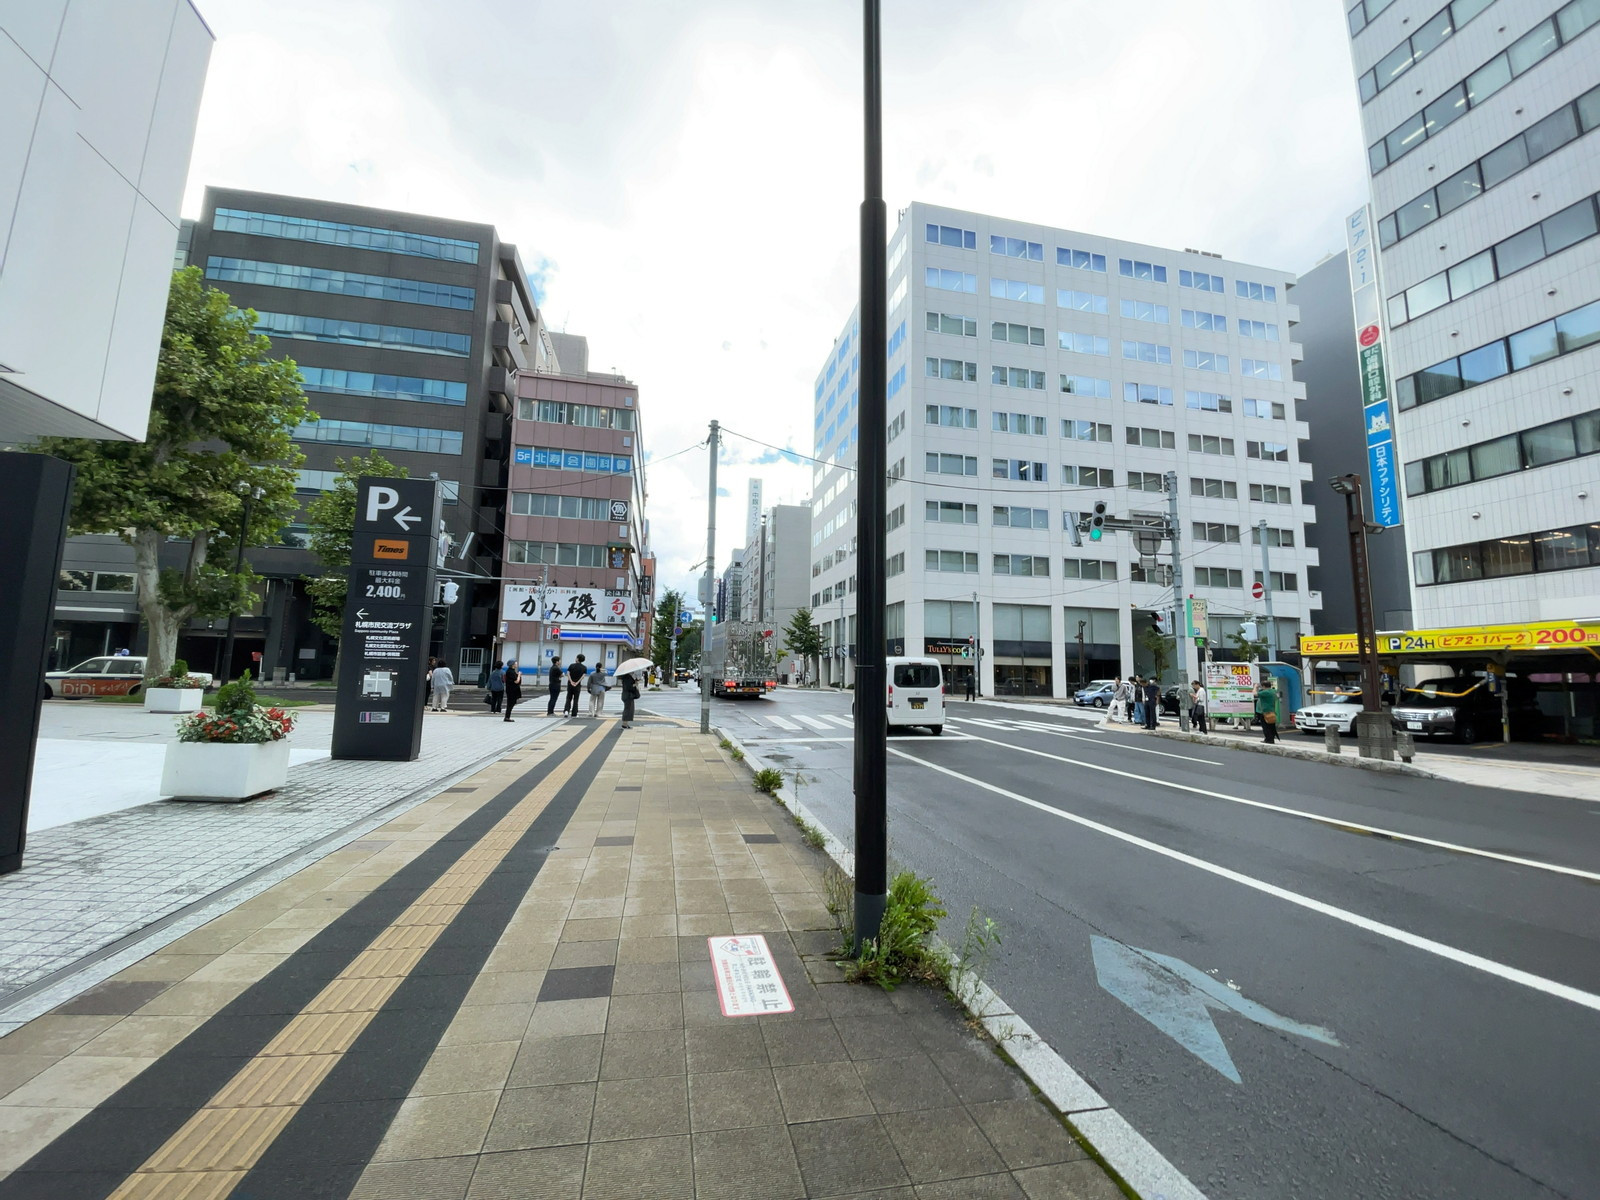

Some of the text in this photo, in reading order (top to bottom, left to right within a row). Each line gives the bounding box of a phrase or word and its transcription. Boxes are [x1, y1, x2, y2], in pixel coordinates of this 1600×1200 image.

[517, 451, 531, 461] 5F
[1376, 446, 1393, 525] 日本ファシリティ
[366, 486, 399, 521] P
[377, 545, 405, 554] Times
[1390, 637, 1400, 649] P
[1405, 636, 1435, 649] 24H
[1231, 666, 1250, 676] 24H
[63, 683, 96, 695] DiDi
